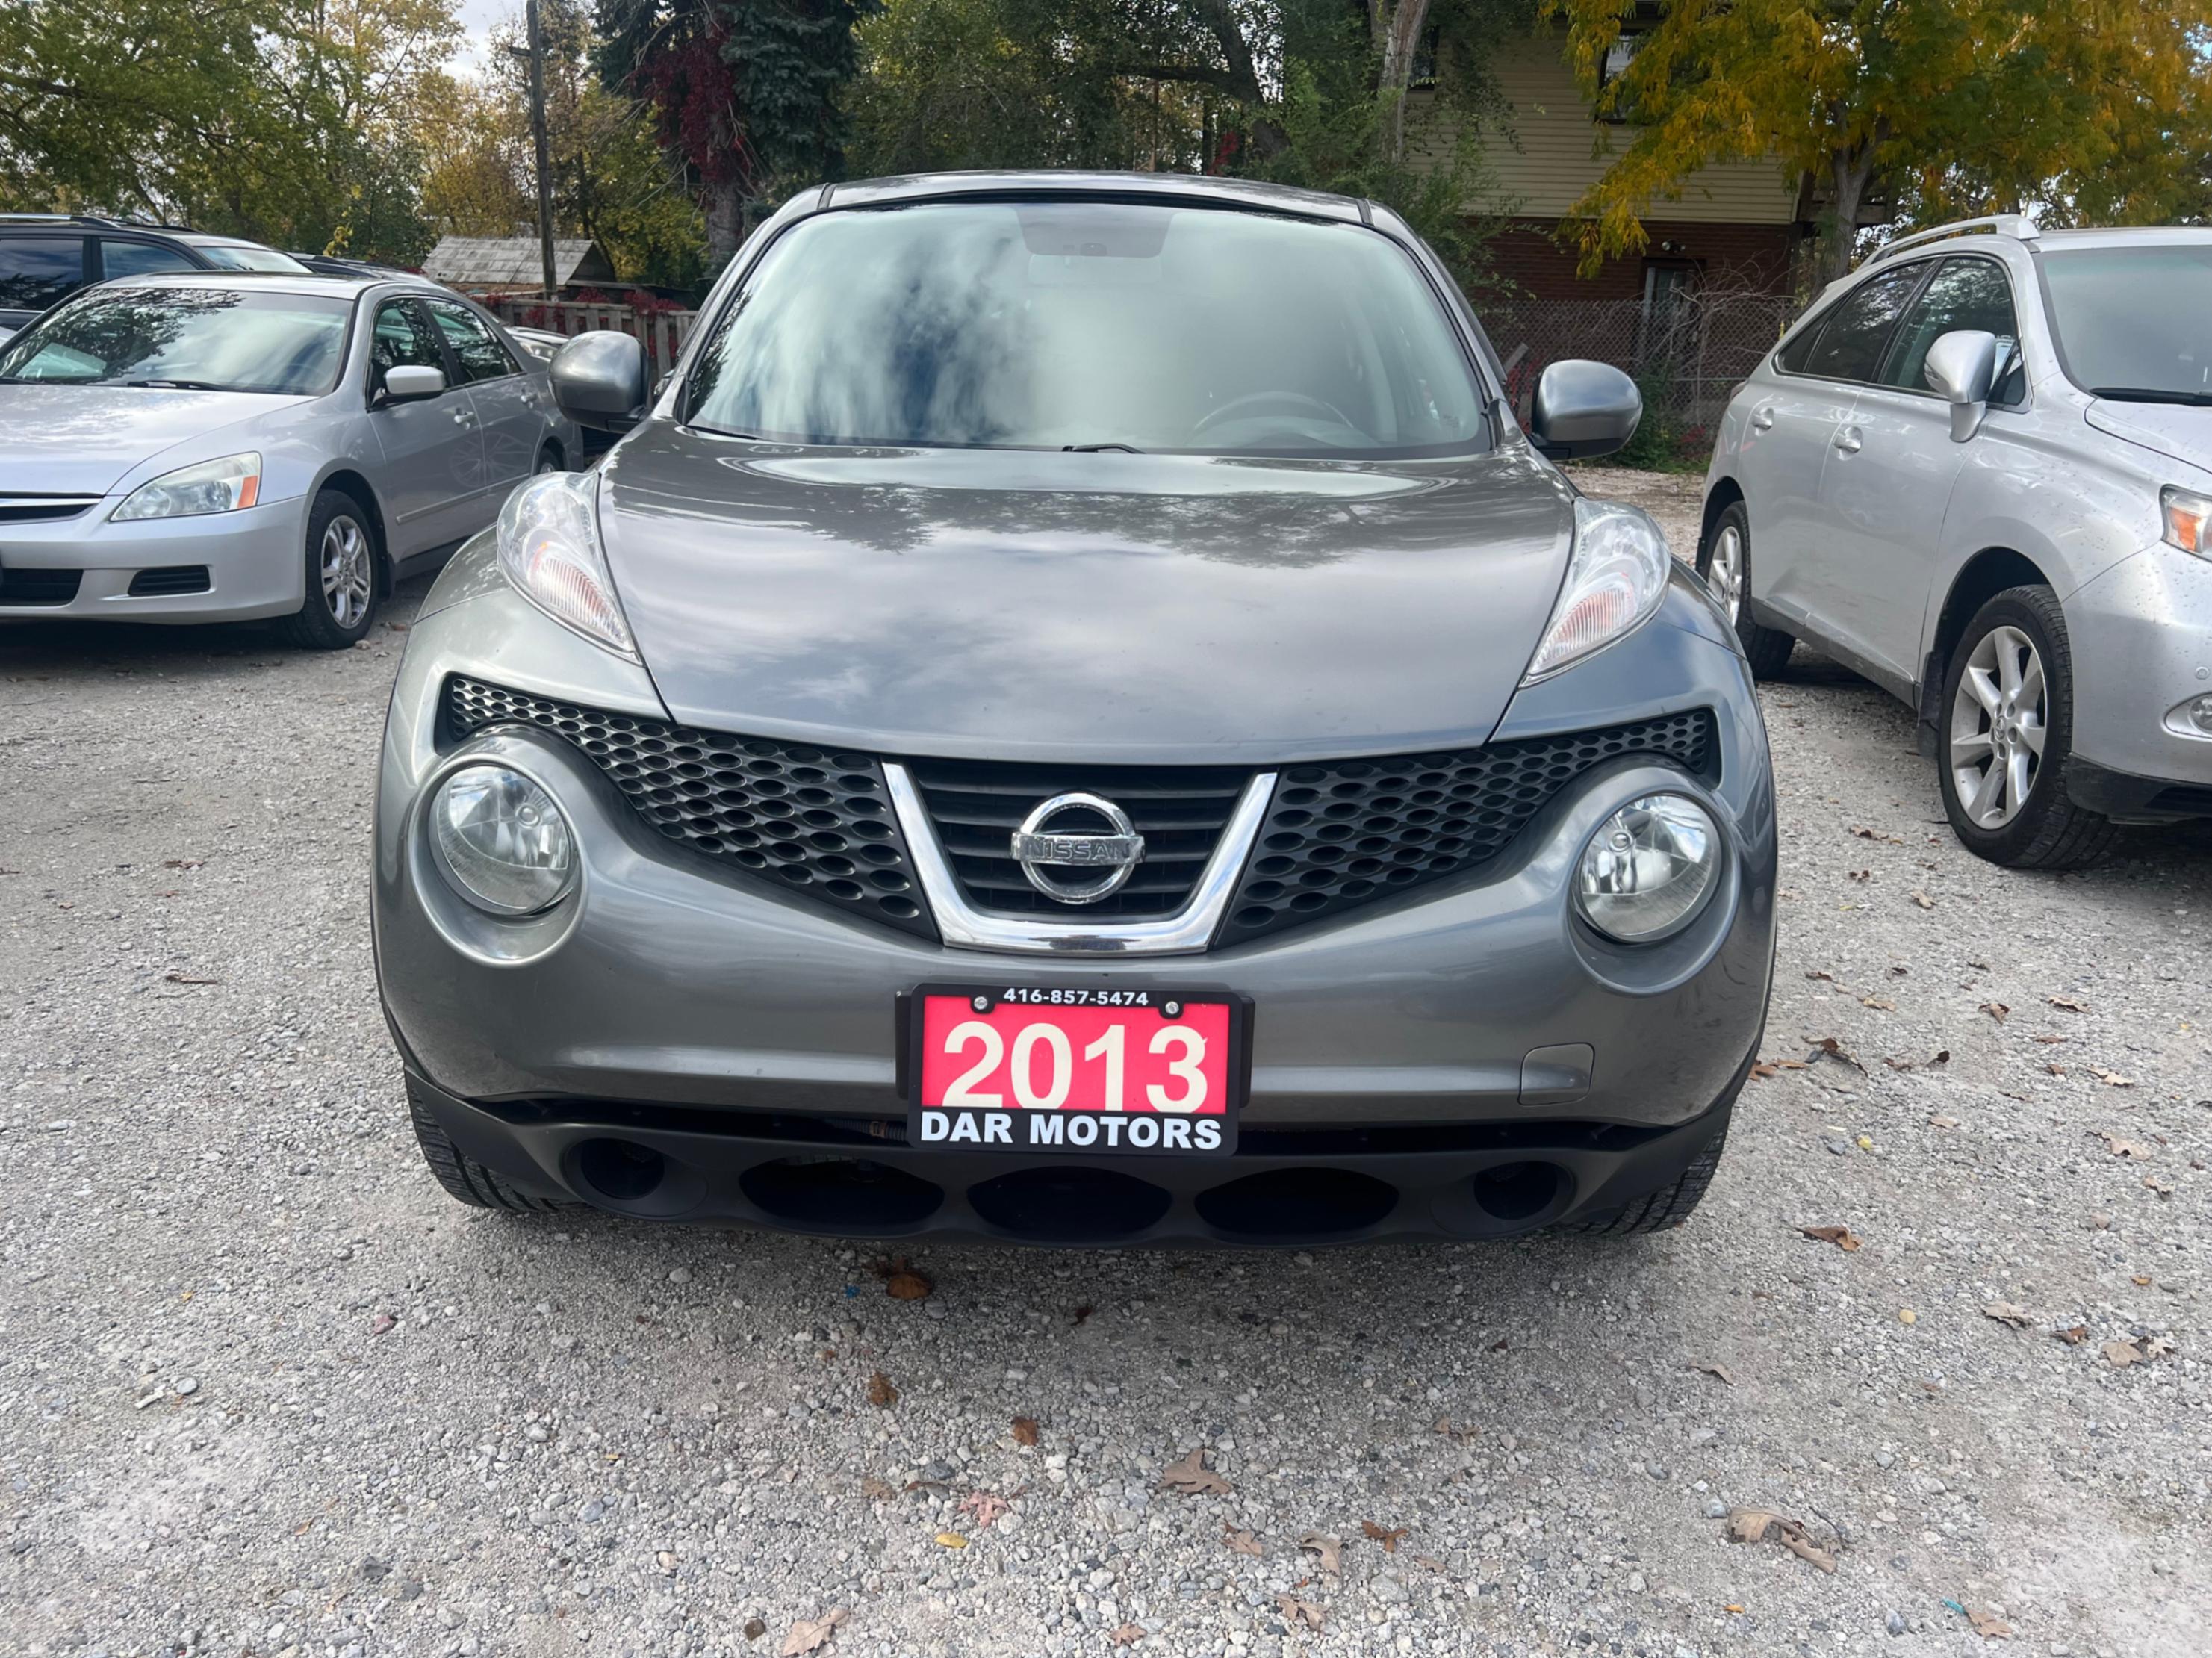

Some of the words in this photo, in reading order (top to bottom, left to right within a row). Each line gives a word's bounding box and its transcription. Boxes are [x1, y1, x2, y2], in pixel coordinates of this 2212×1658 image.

[1028, 839, 1131, 860] NISSAN
[1004, 988, 1149, 1006] 416-857-5474
[942, 1021, 1208, 1114] 2013
[921, 1111, 1013, 1143] DAR
[1029, 1114, 1222, 1149] MOTORS
